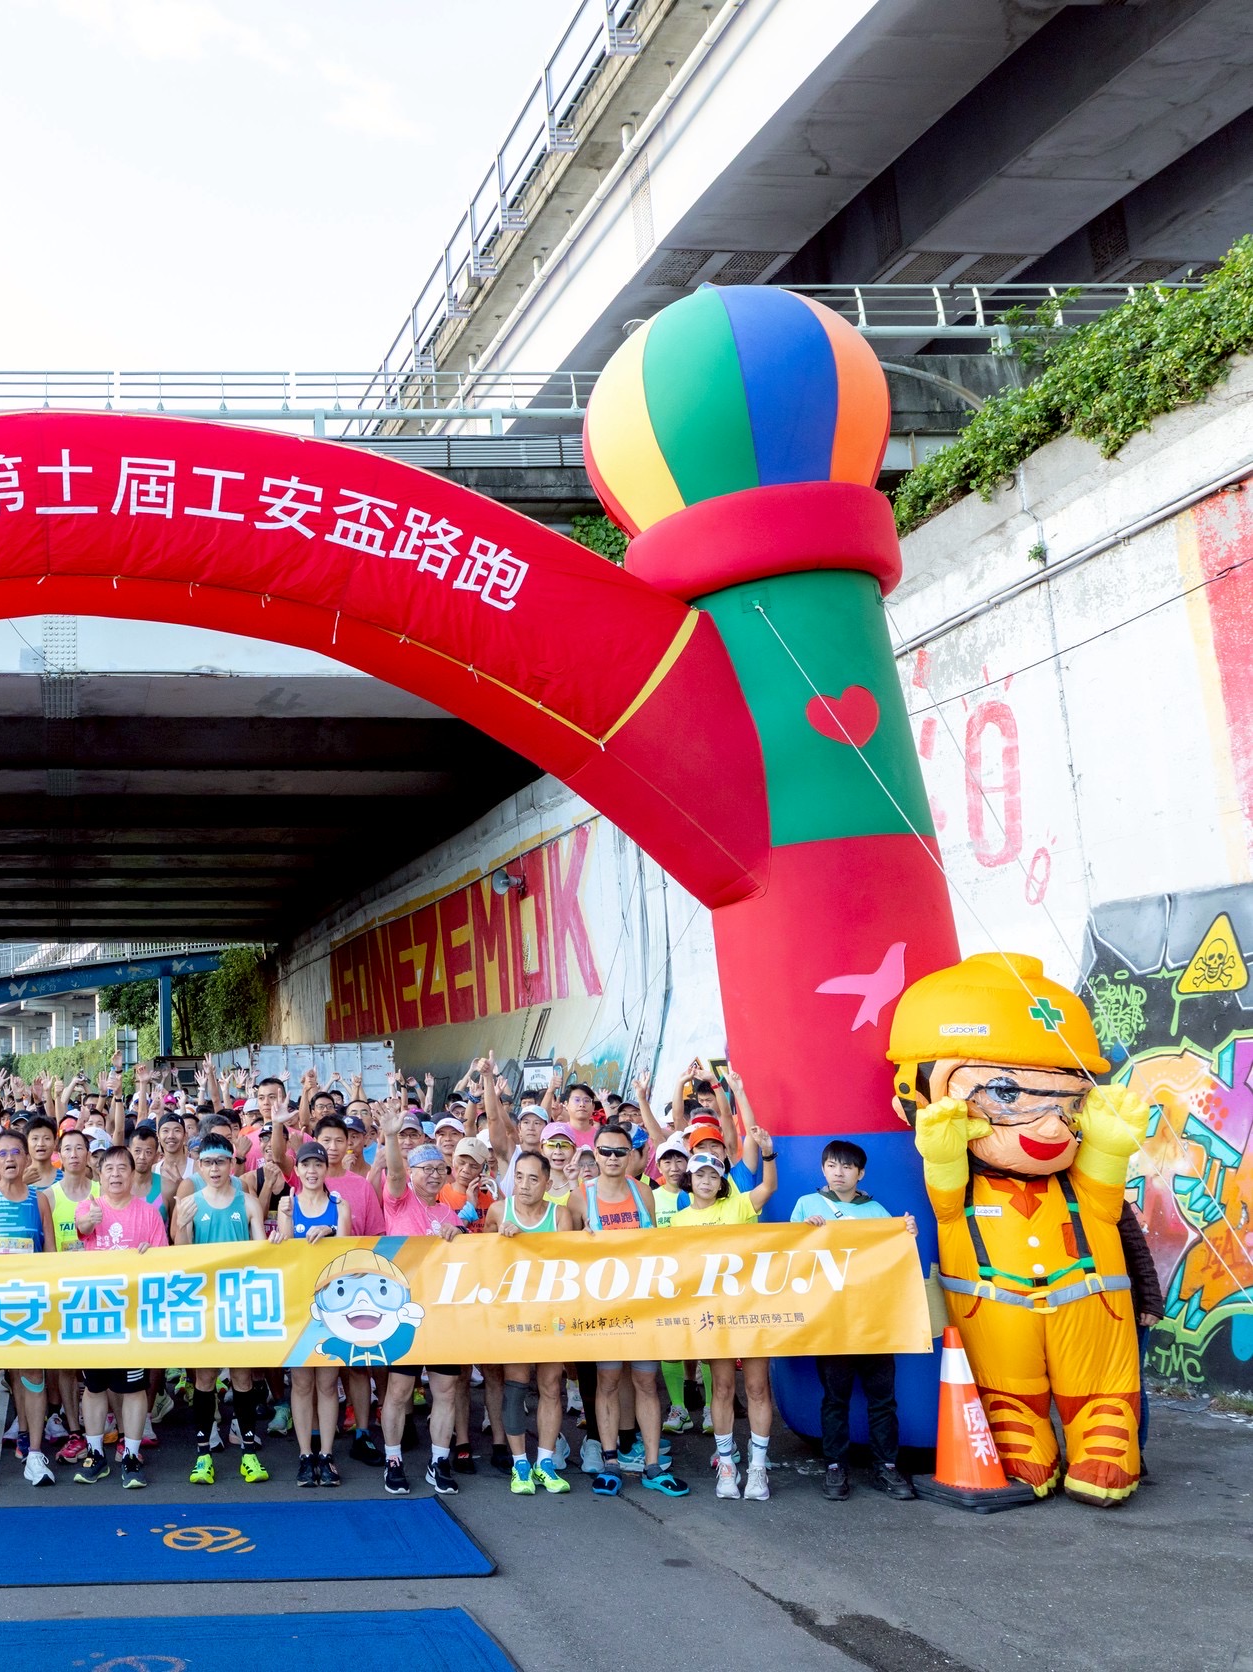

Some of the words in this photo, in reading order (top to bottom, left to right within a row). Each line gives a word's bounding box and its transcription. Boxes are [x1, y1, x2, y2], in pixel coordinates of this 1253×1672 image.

[432, 1255, 683, 1305] LABOR
[691, 1248, 857, 1299] RUN
[571, 1315, 634, 1331] 新北市政府
[717, 1312, 805, 1326] 新北市政府勞工局
